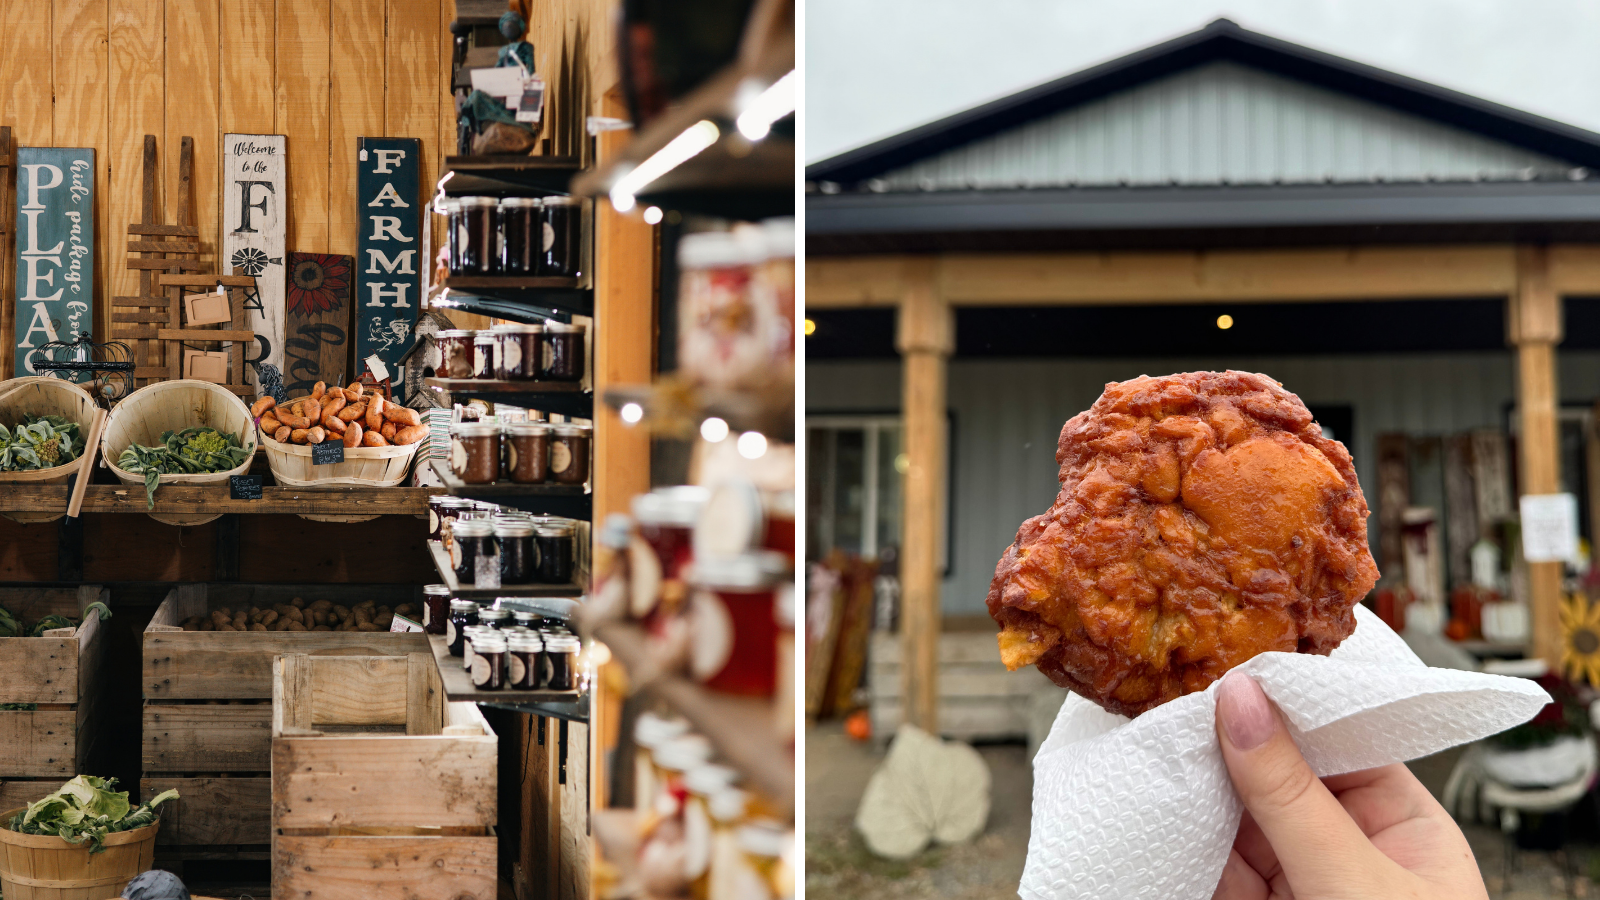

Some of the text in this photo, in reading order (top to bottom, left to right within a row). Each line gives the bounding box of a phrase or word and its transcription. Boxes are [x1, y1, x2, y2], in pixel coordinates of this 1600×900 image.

[233, 142, 277, 156] Welcome
[242, 161, 268, 173] to the
[69, 160, 90, 204] hide
[64, 211, 89, 294] package
